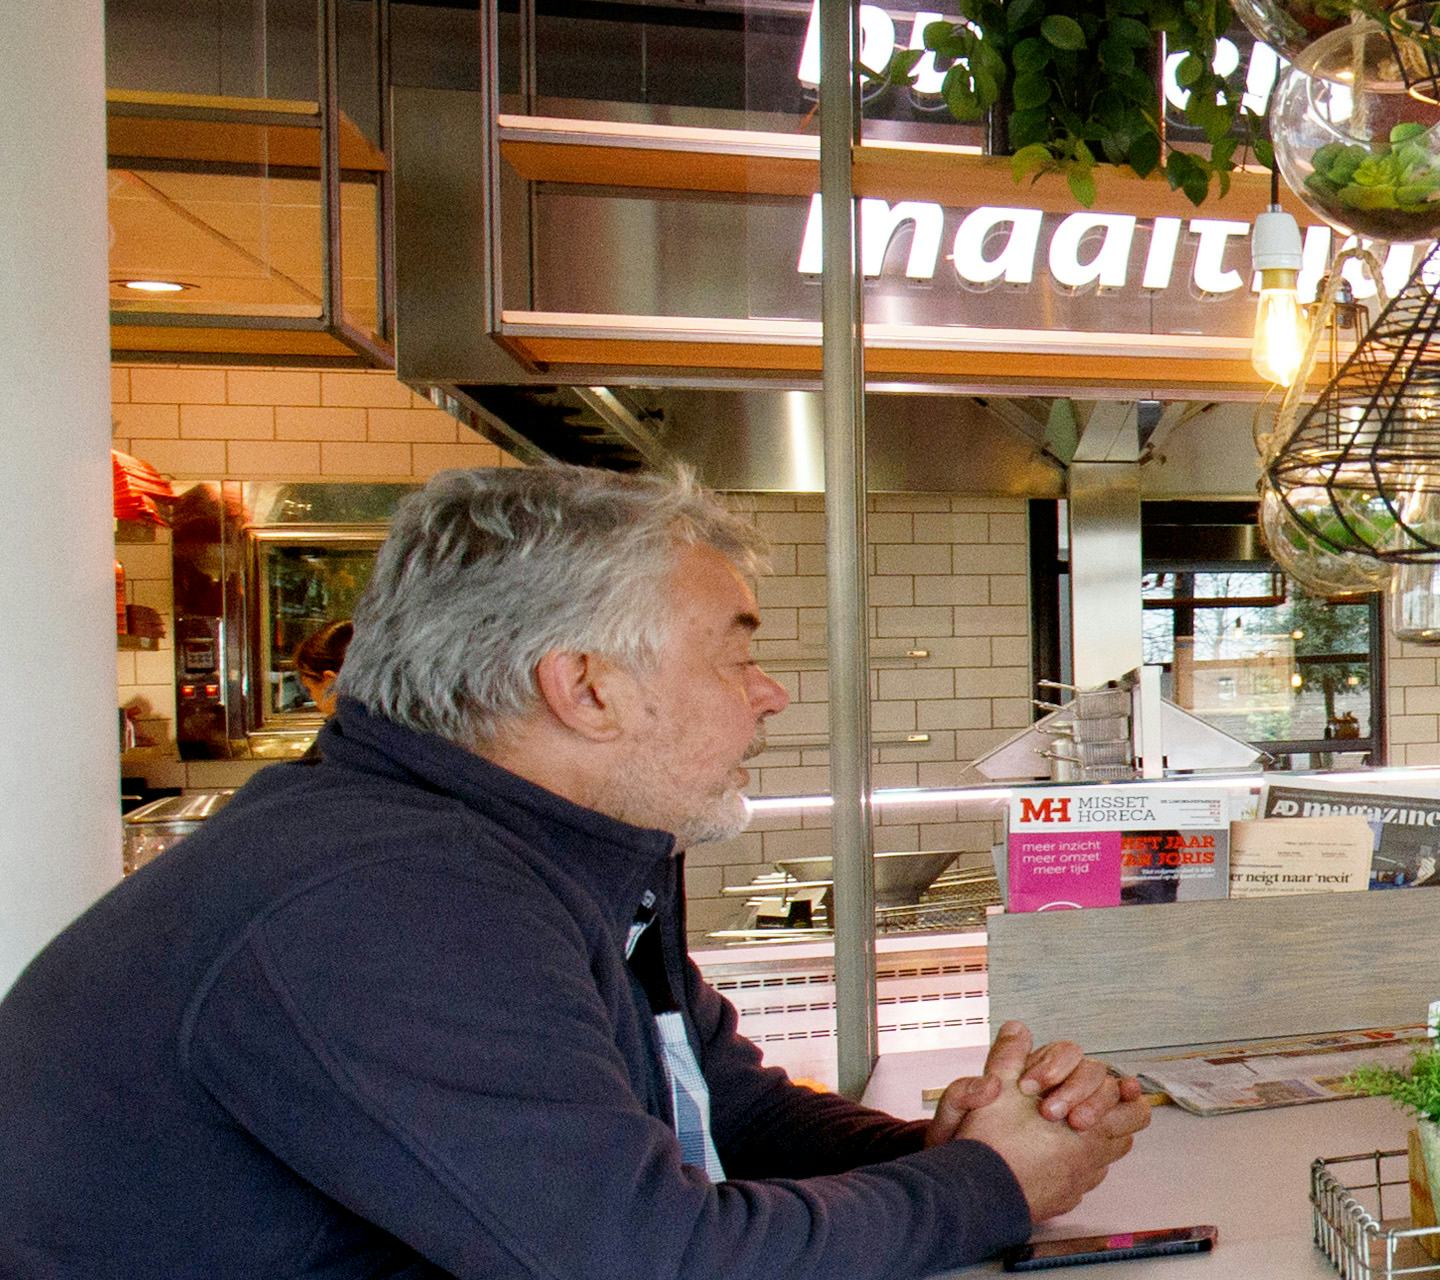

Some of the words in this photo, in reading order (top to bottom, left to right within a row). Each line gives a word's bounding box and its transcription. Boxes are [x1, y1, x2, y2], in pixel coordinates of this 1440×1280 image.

[1020, 798, 1071, 823] MH
[1078, 796, 1149, 809] MISSET
[1271, 799, 1299, 817] AD
[1078, 809, 1156, 822] HORECA
[1022, 843, 1055, 852] meer
[1059, 840, 1101, 851] inzicht
[1160, 835, 1215, 849] JAAR
[1022, 854, 1055, 863] meer
[1059, 851, 1101, 862] omzet
[1158, 851, 1215, 866] JORIS
[1033, 865, 1066, 874] meer
[1070, 863, 1089, 875] tijd
[1247, 872, 1279, 885] neigt
[1282, 873, 1312, 884] naar
